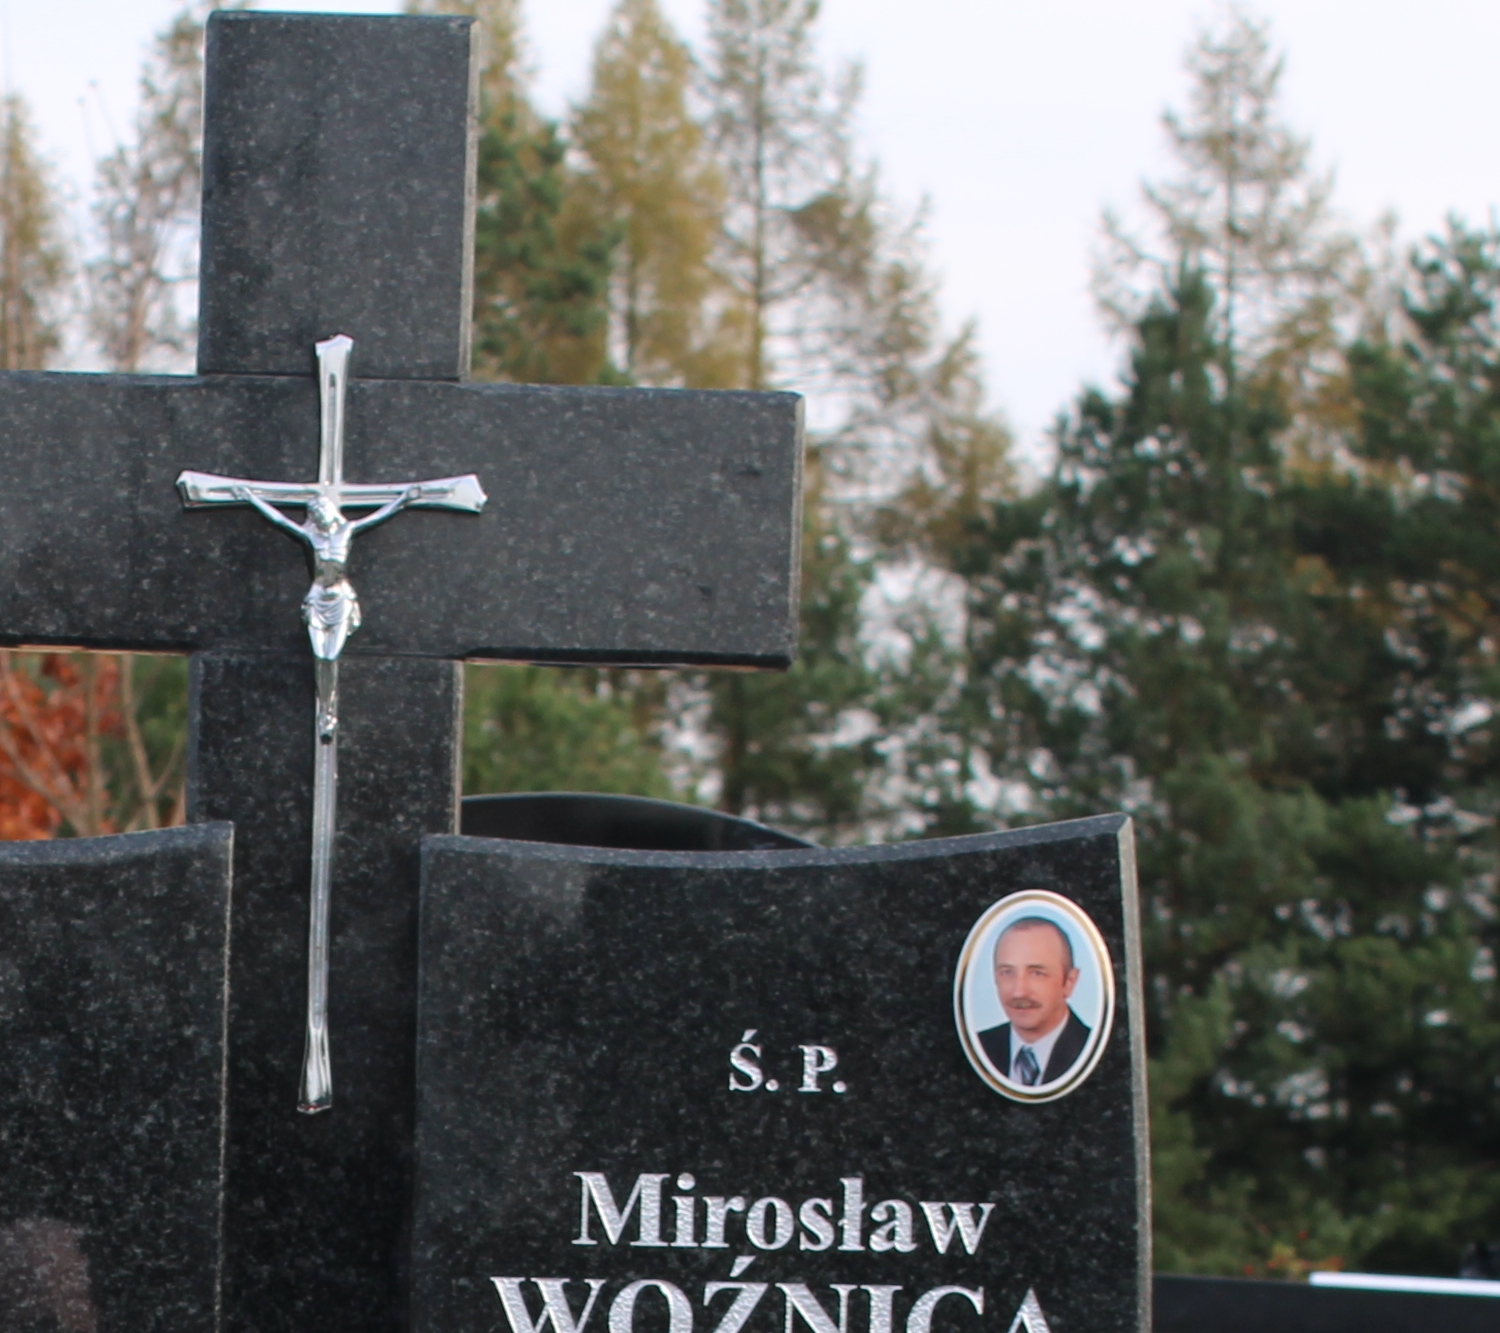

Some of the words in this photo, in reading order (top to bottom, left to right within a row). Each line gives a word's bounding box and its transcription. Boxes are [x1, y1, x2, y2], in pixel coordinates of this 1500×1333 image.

[729, 1030, 779, 1092] Ś.
[799, 1045, 847, 1094] P.
[571, 1171, 996, 1255] Mirosław
